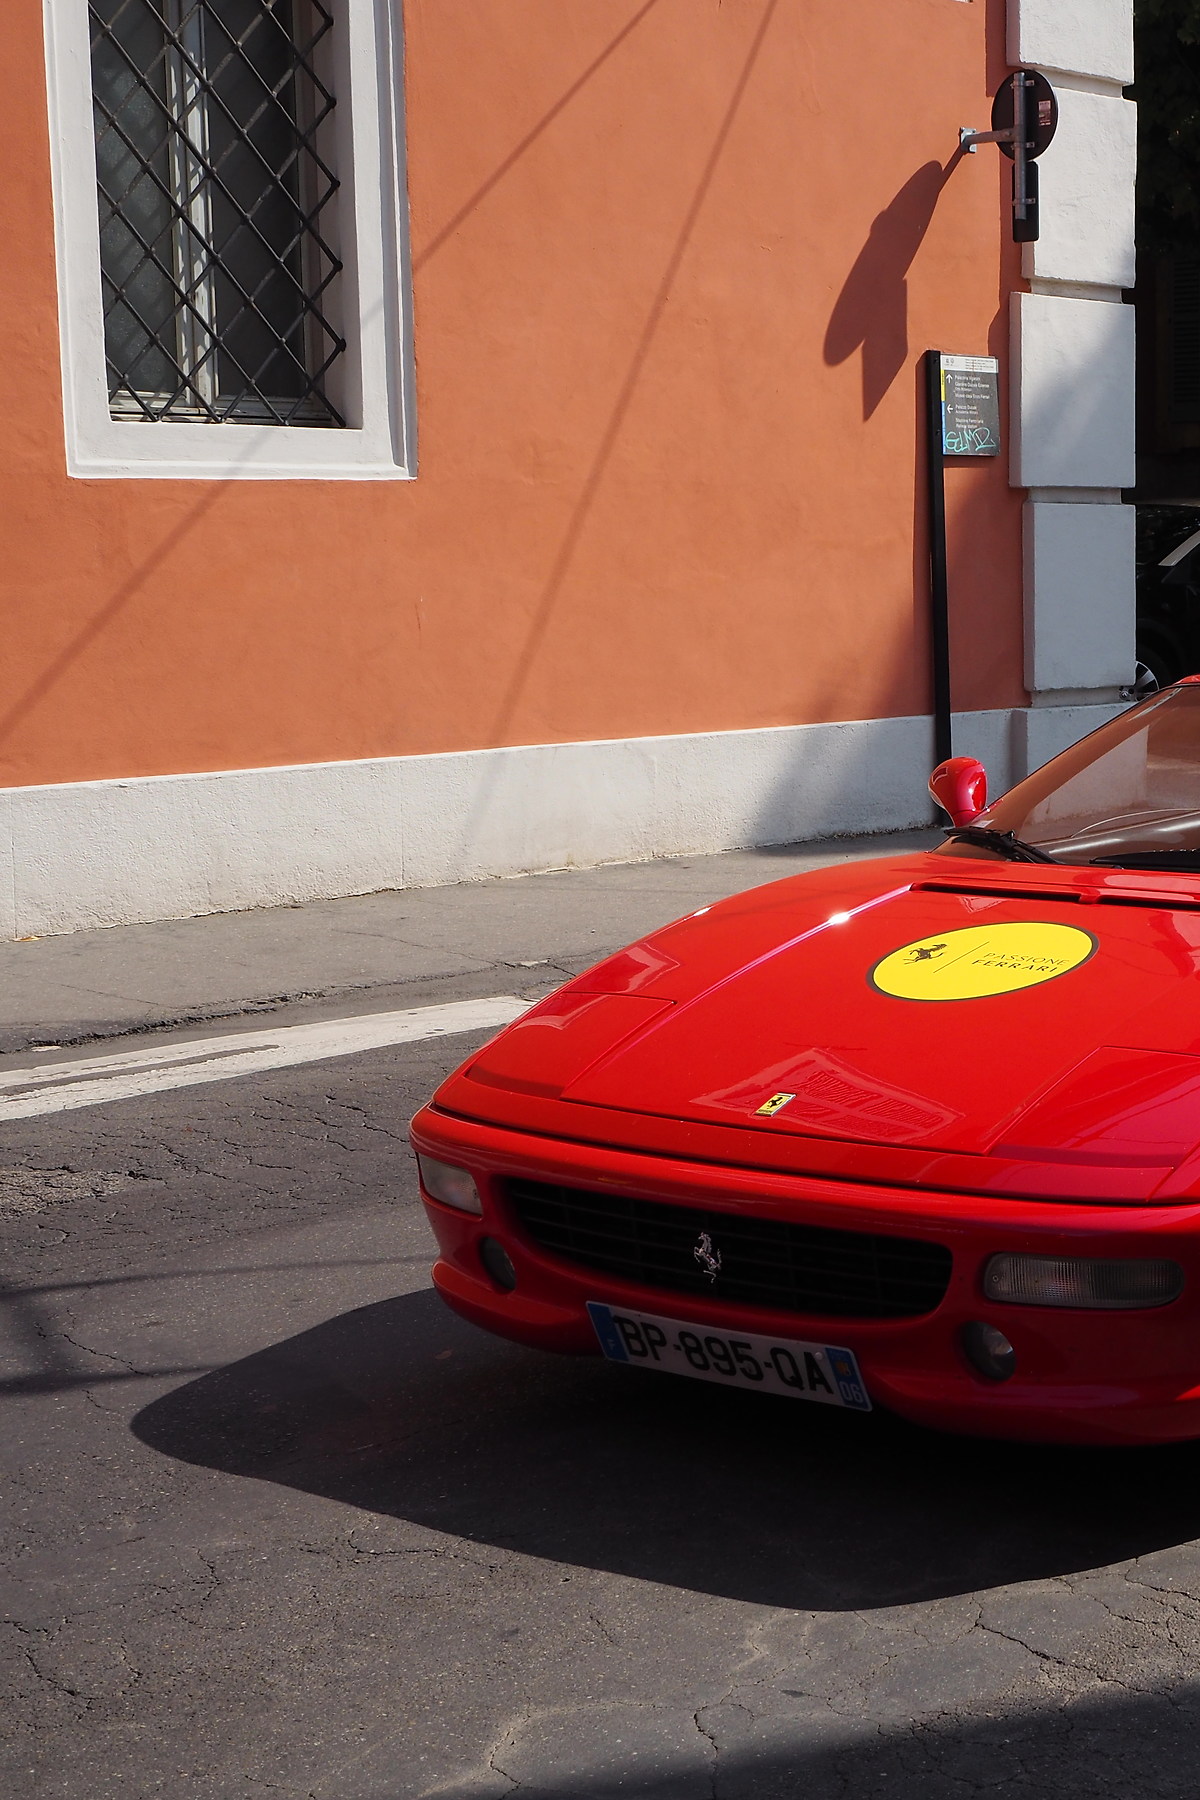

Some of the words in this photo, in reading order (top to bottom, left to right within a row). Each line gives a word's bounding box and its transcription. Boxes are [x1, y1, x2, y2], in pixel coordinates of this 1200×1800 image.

[972, 959, 1059, 973] FERRARI
[983, 952, 1070, 966] PASSIONE
[612, 1315, 834, 1395] BP-895-QA
[840, 1380, 865, 1404] 06
